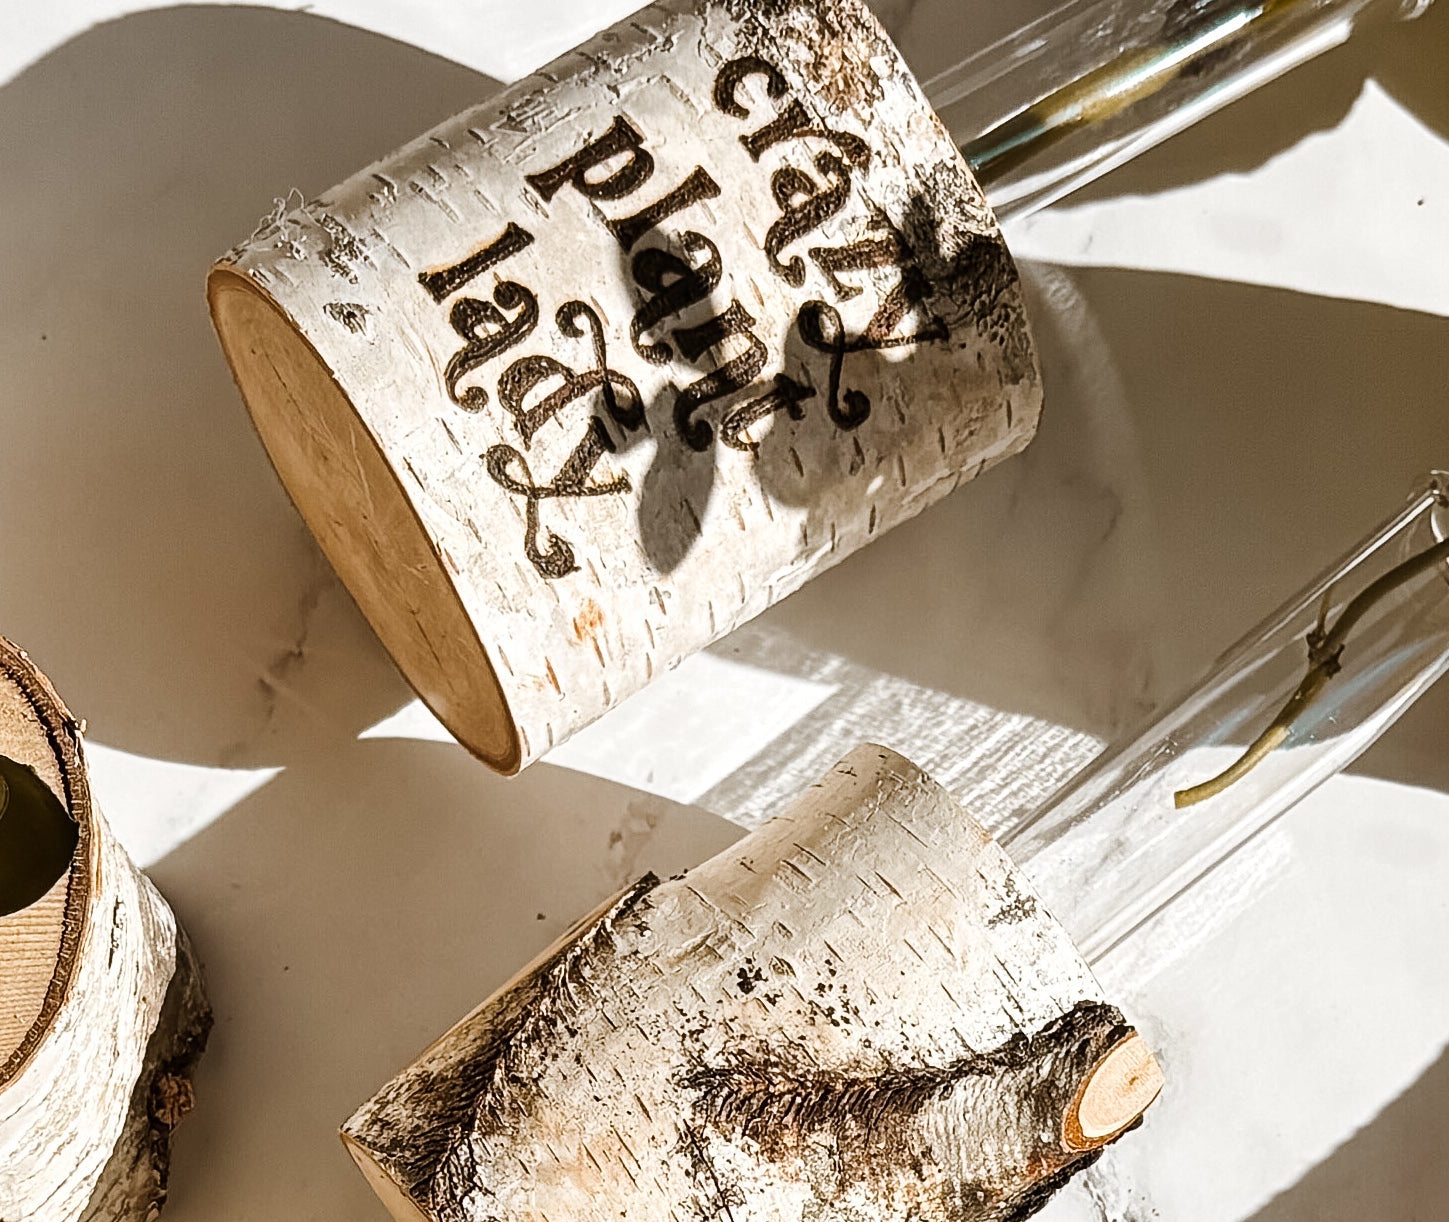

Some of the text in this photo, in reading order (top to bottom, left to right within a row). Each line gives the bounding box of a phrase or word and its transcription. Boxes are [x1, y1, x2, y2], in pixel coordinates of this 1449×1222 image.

[417, 221, 649, 581] lady
[524, 114, 817, 453] plant
[713, 54, 950, 433] crazy
